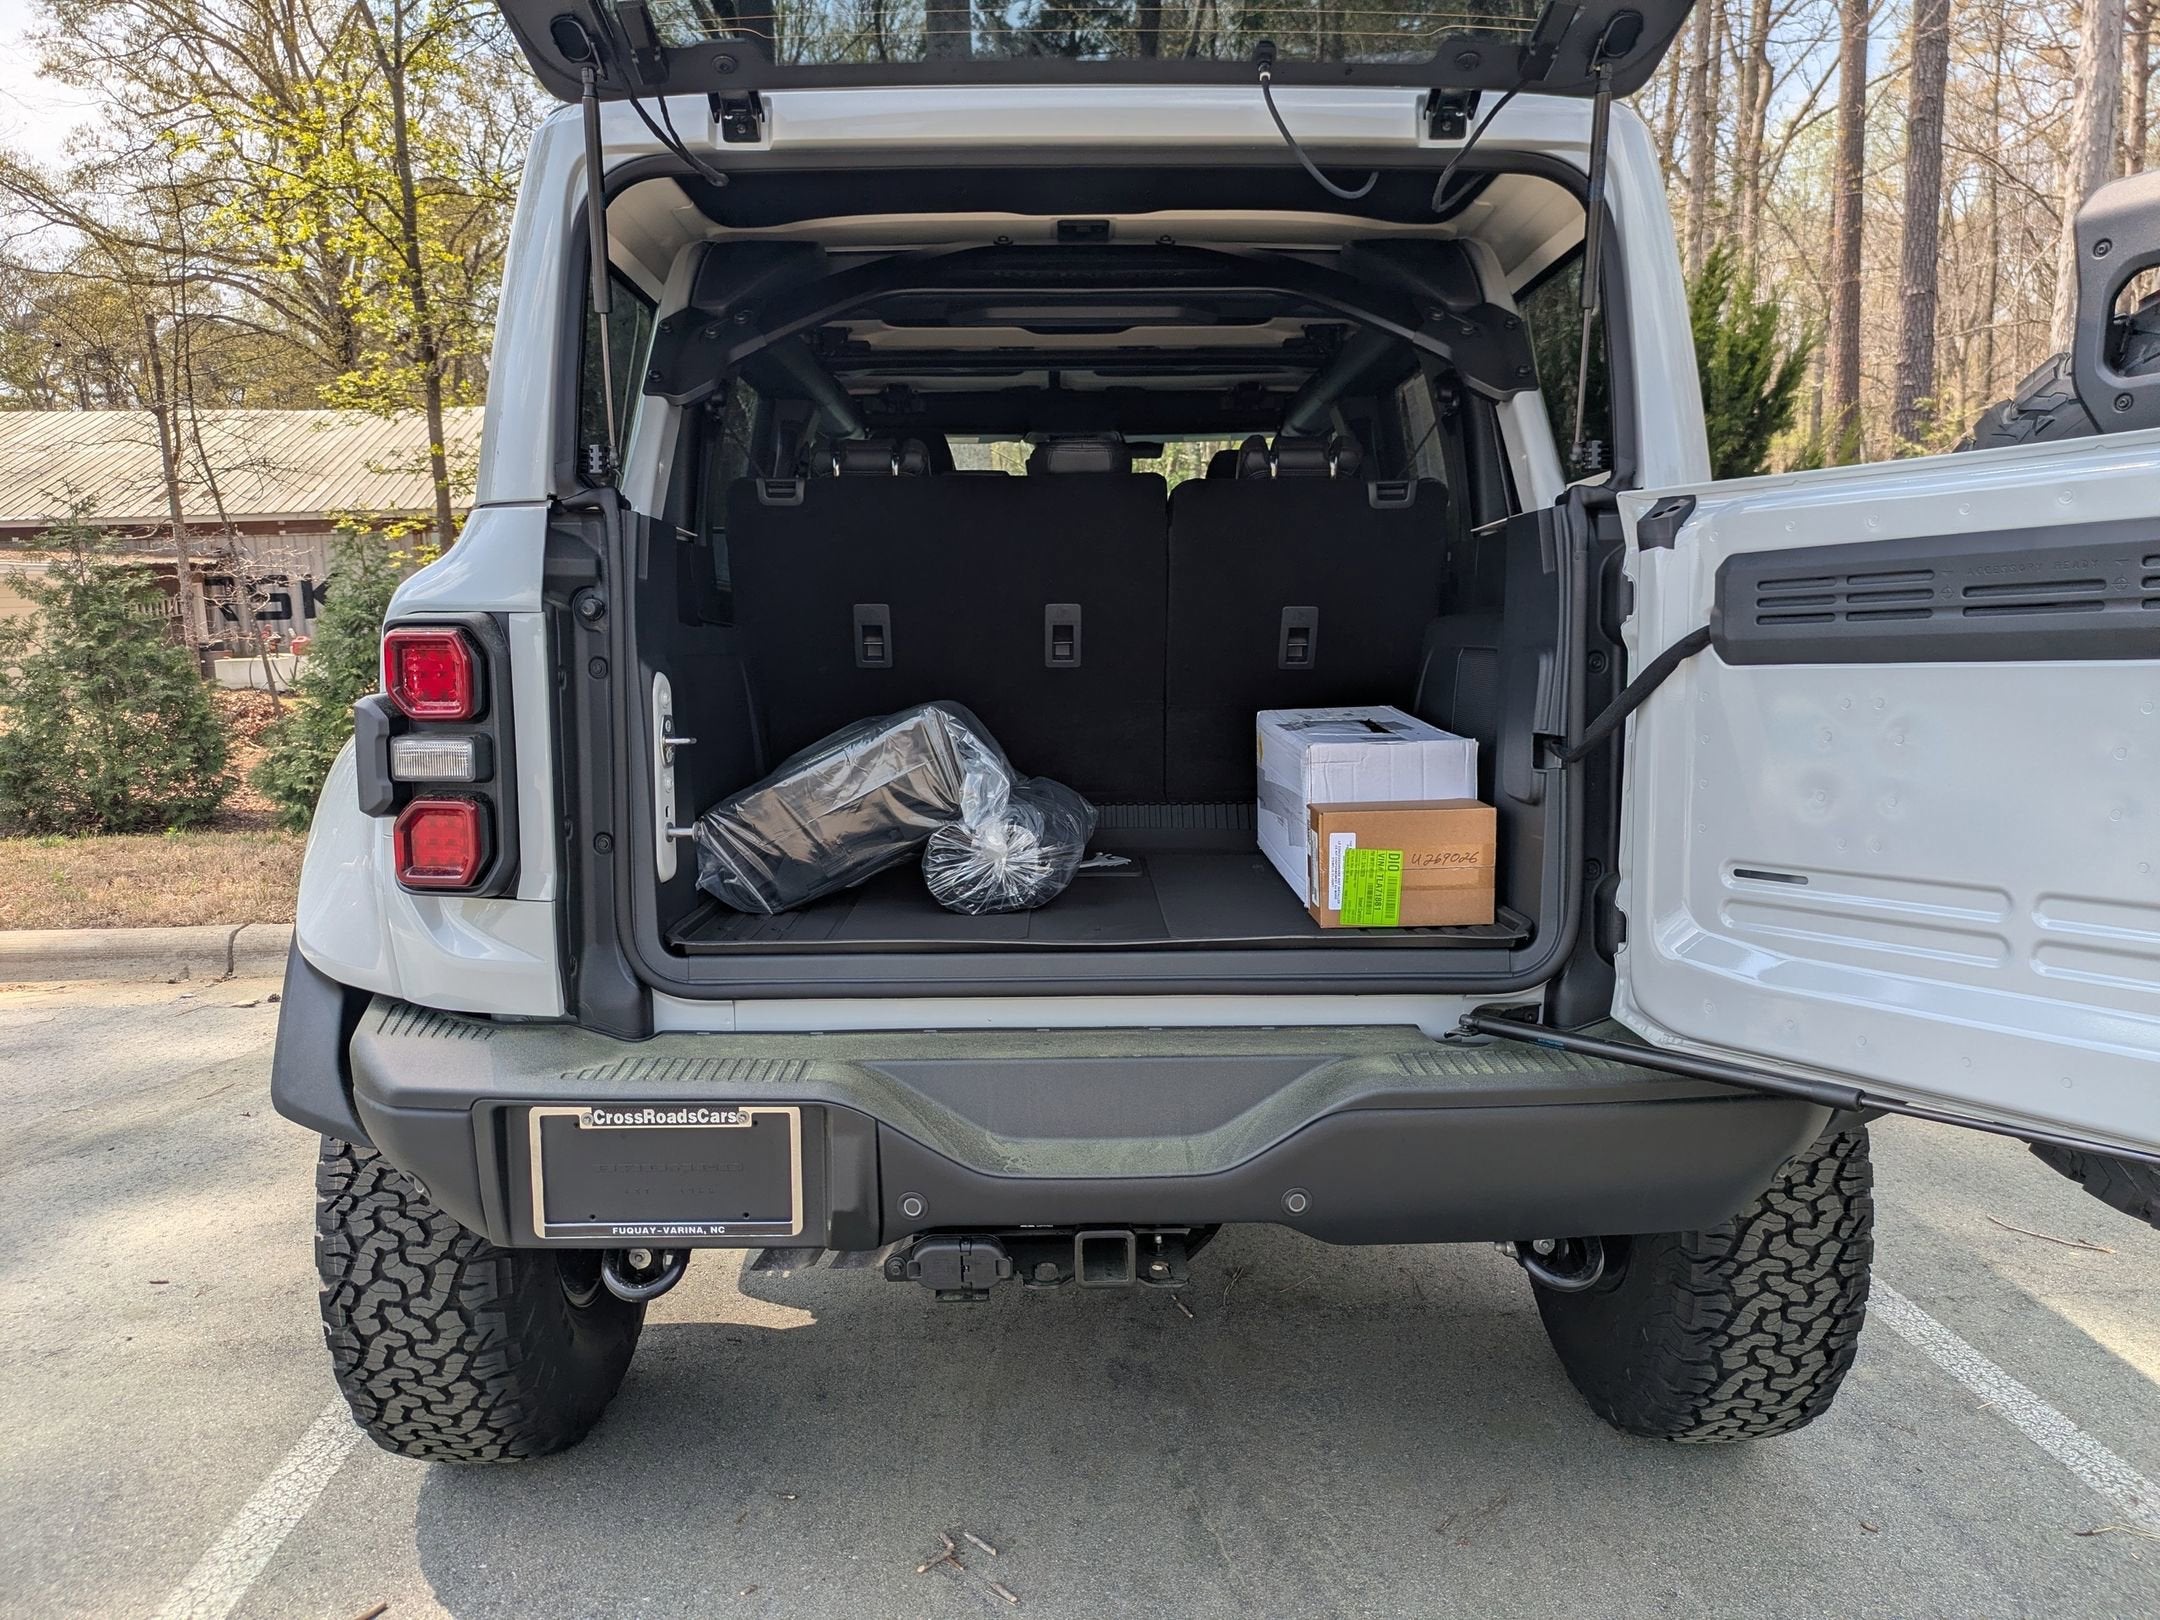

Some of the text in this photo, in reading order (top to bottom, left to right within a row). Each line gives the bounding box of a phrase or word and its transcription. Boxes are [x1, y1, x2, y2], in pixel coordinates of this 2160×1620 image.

[1967, 559, 2099, 577] ACCESSORY READY
[1387, 853, 1401, 872] DIO
[593, 1108, 737, 1125] CrossRoadsCars
[612, 1226, 726, 1235] FUQUAY-VARINA, NC
